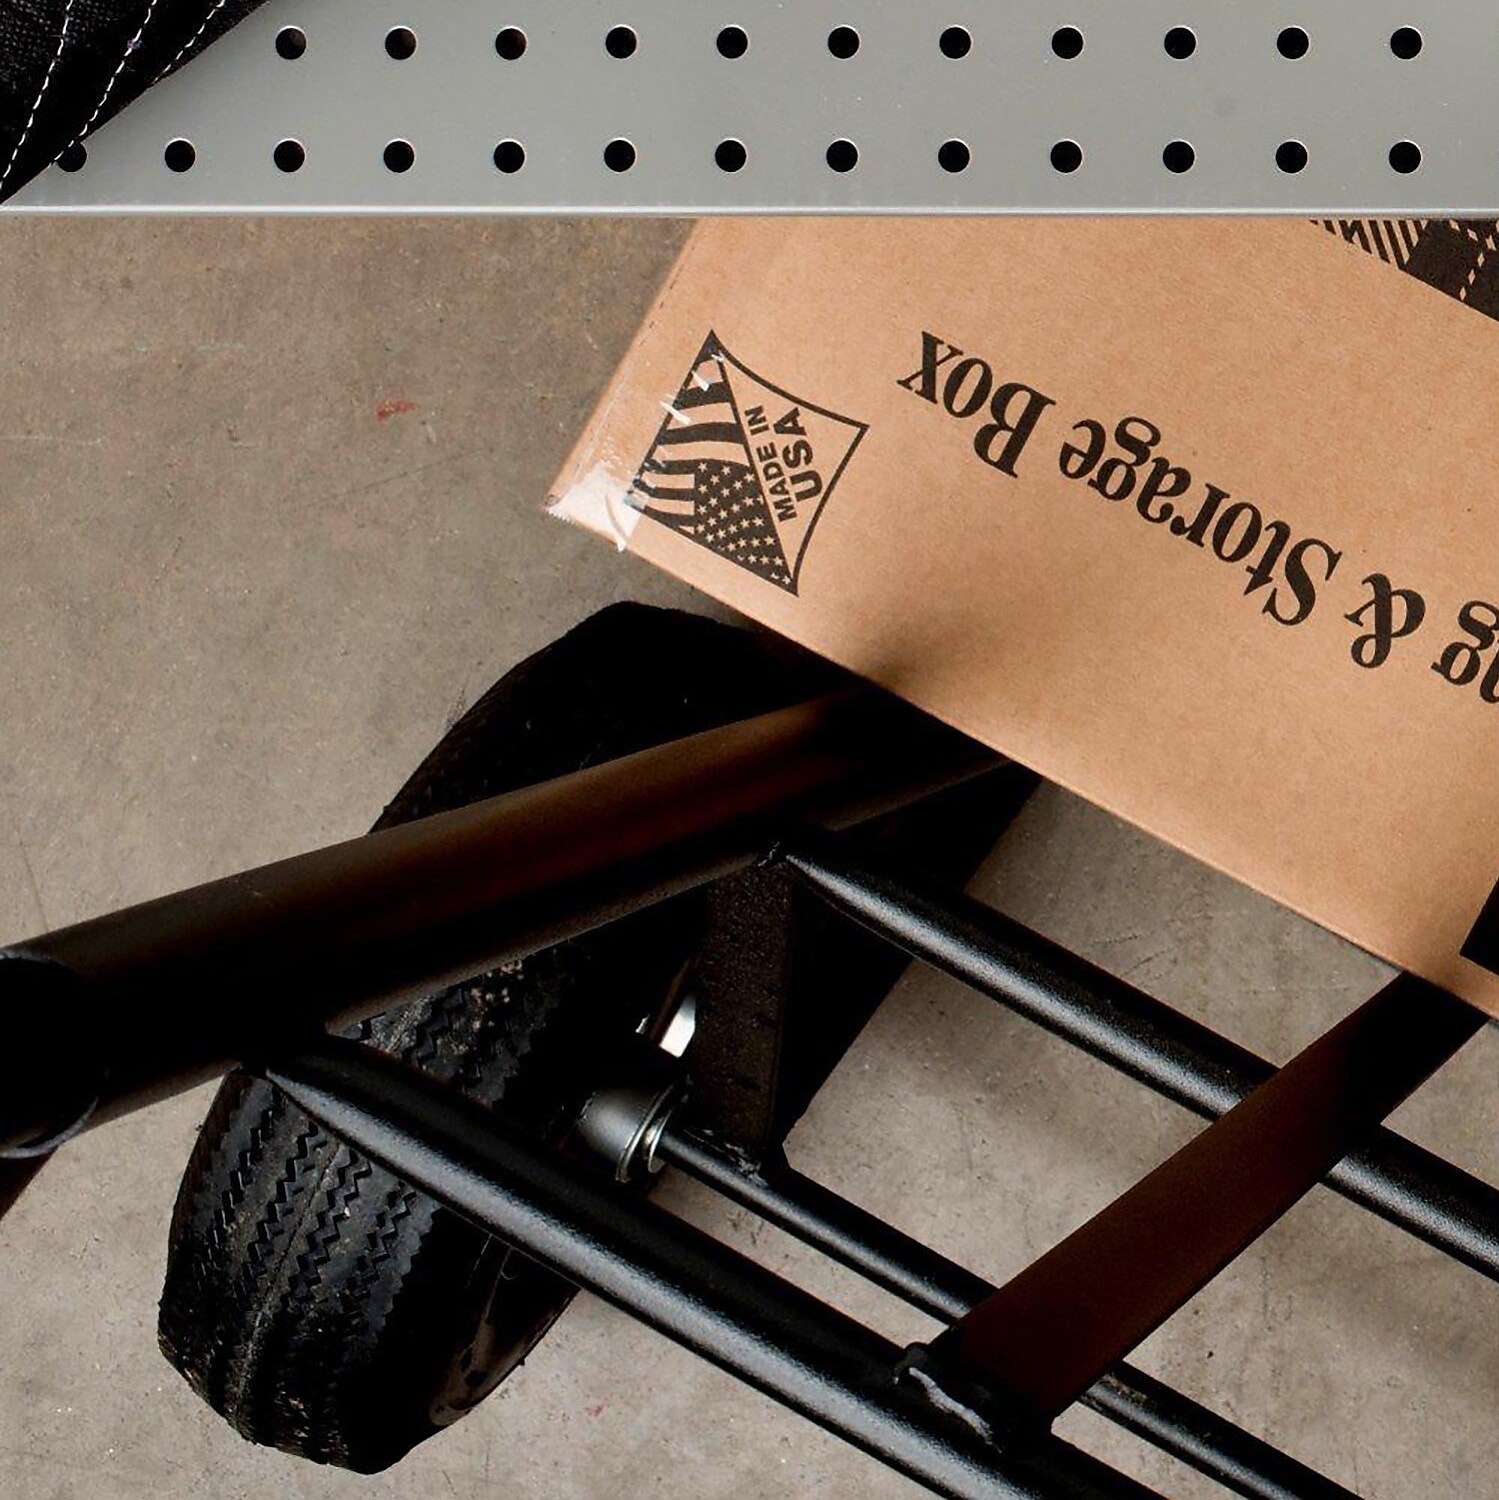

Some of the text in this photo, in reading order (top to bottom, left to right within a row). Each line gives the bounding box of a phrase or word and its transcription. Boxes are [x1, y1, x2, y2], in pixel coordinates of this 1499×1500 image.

[773, 407, 823, 503] USA
[898, 331, 1056, 478] Box
[744, 405, 797, 523] MADE IN
[1060, 417, 1342, 625] Storage
[1345, 574, 1427, 670] &
